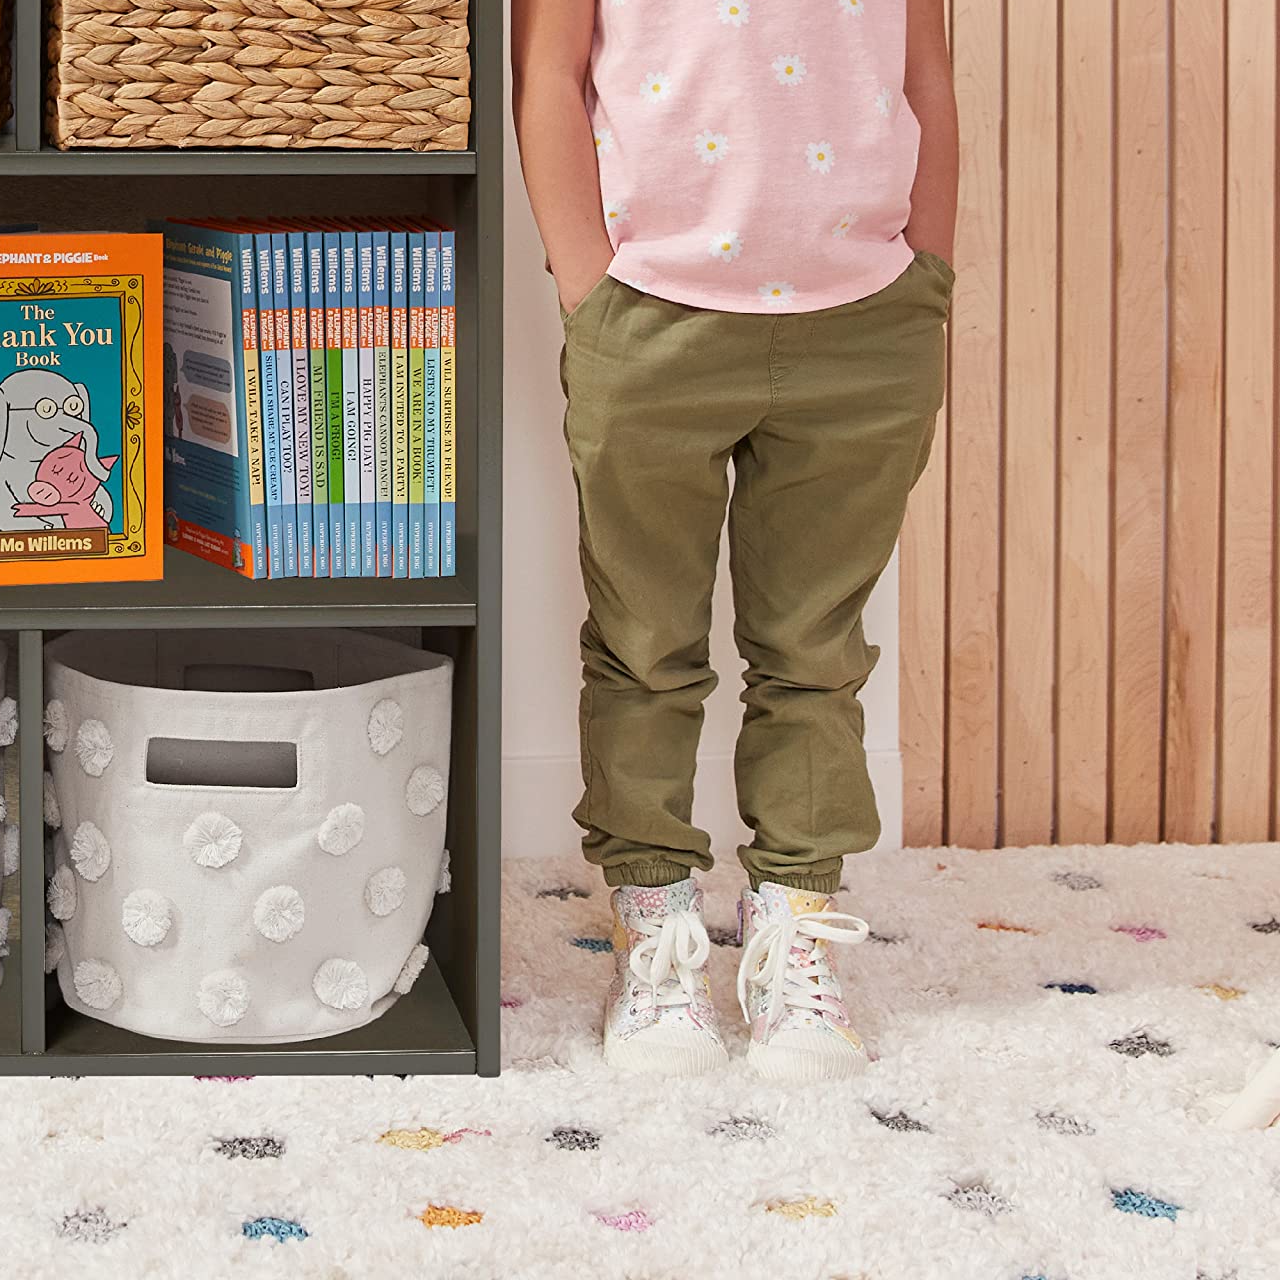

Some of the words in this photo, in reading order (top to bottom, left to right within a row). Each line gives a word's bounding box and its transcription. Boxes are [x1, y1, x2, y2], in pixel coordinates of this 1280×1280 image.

[43, 253, 52, 263] &
[54, 252, 93, 263] PIGGIE
[242, 249, 252, 294] Willems
[260, 250, 269, 294] Willems
[275, 249, 284, 294] Willems
[293, 248, 302, 293] Willems
[311, 248, 320, 293] Willems
[328, 248, 337, 293] Willems
[344, 248, 353, 292] Willems
[362, 247, 371, 292] Willems
[377, 246, 386, 290] Willems
[395, 248, 404, 292] Willems
[413, 247, 422, 292] Willems
[426, 248, 436, 292] Willems
[442, 247, 452, 290] Willems
[21, 305, 55, 320] The
[62, 322, 113, 346] You
[16, 352, 61, 367] Book
[397, 363, 404, 378] AM
[297, 366, 307, 401] LOVE
[313, 366, 323, 384] MY
[379, 352, 387, 412] ELEPHANTS
[413, 368, 421, 387] WE
[427, 359, 435, 397] LISTEN
[248, 377, 256, 407] WILL
[265, 356, 273, 391] SHOULD
[269, 432, 275, 444] MY
[281, 381, 289, 403] CAN
[331, 392, 340, 408] I'M
[363, 379, 372, 417] HAPPY
[413, 391, 421, 415] ARE
[298, 406, 307, 425] MY
[314, 391, 324, 440] FRIEND
[347, 400, 355, 415] AM
[427, 401, 435, 415] TO
[444, 387, 452, 436] SURPRISE
[250, 411, 258, 442] TAKE
[282, 414, 291, 442] PLAY
[363, 421, 372, 440] PIG
[397, 430, 404, 443] TO
[413, 420, 421, 431] IN
[413, 435, 421, 443] A
[428, 419, 435, 433] MY
[299, 431, 308, 462] NEW
[315, 445, 324, 457] IS
[332, 425, 340, 460] FROG!
[347, 421, 356, 461] GOING!
[445, 440, 452, 453] MY
[252, 458, 260, 485] NAP!
[283, 445, 292, 473] TOO?
[364, 445, 372, 473] DAY!
[413, 448, 421, 483] BOOK!
[427, 438, 435, 492] TRUMPET!
[300, 466, 309, 496] TOY!
[316, 462, 326, 488] SAD
[380, 460, 388, 496] DANCE!
[444, 458, 452, 497] FRIEND!
[0, 538, 24, 552] Mo
[28, 536, 92, 551] Willems
